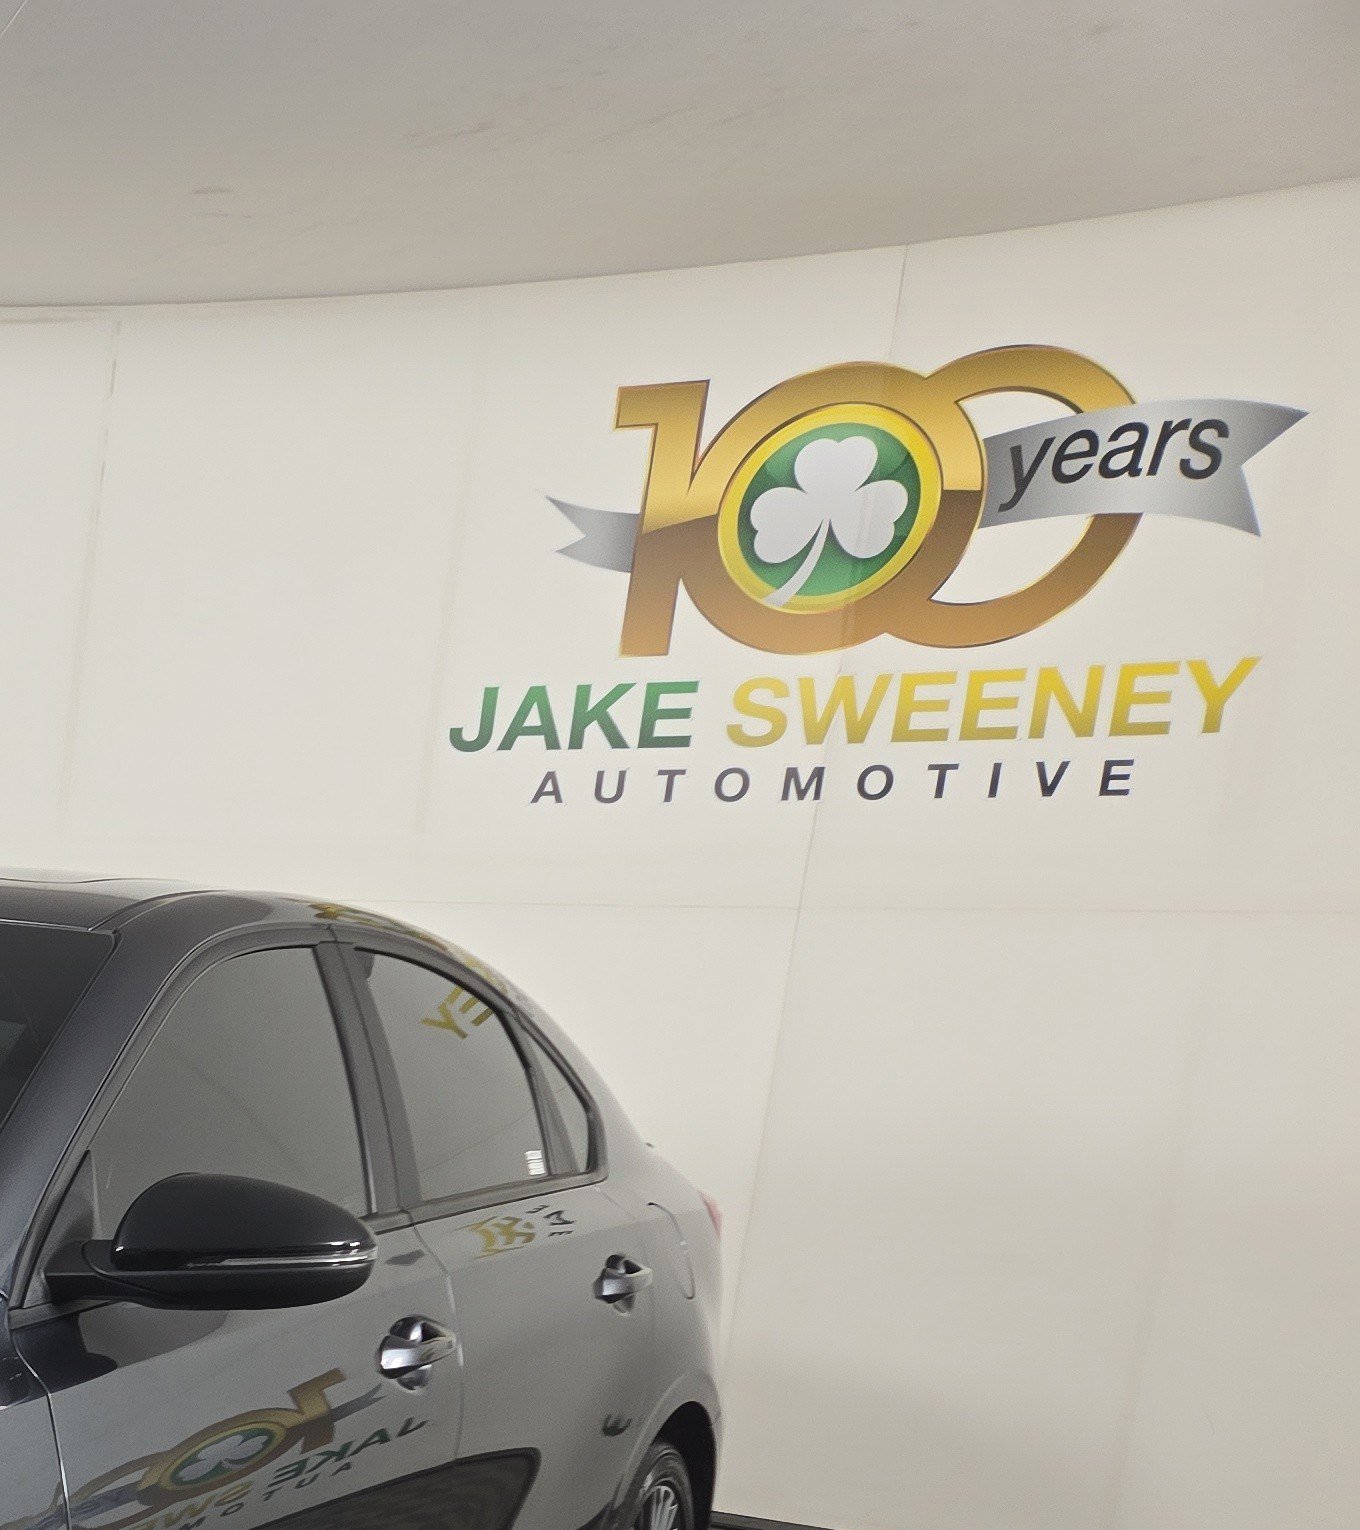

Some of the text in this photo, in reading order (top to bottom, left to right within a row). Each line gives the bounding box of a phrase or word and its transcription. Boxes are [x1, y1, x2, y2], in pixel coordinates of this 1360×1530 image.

[613, 344, 1229, 658] 100 years
[448, 656, 1263, 753] JAKE SWEENEY
[532, 758, 1136, 806] AUTOMOTIVE
